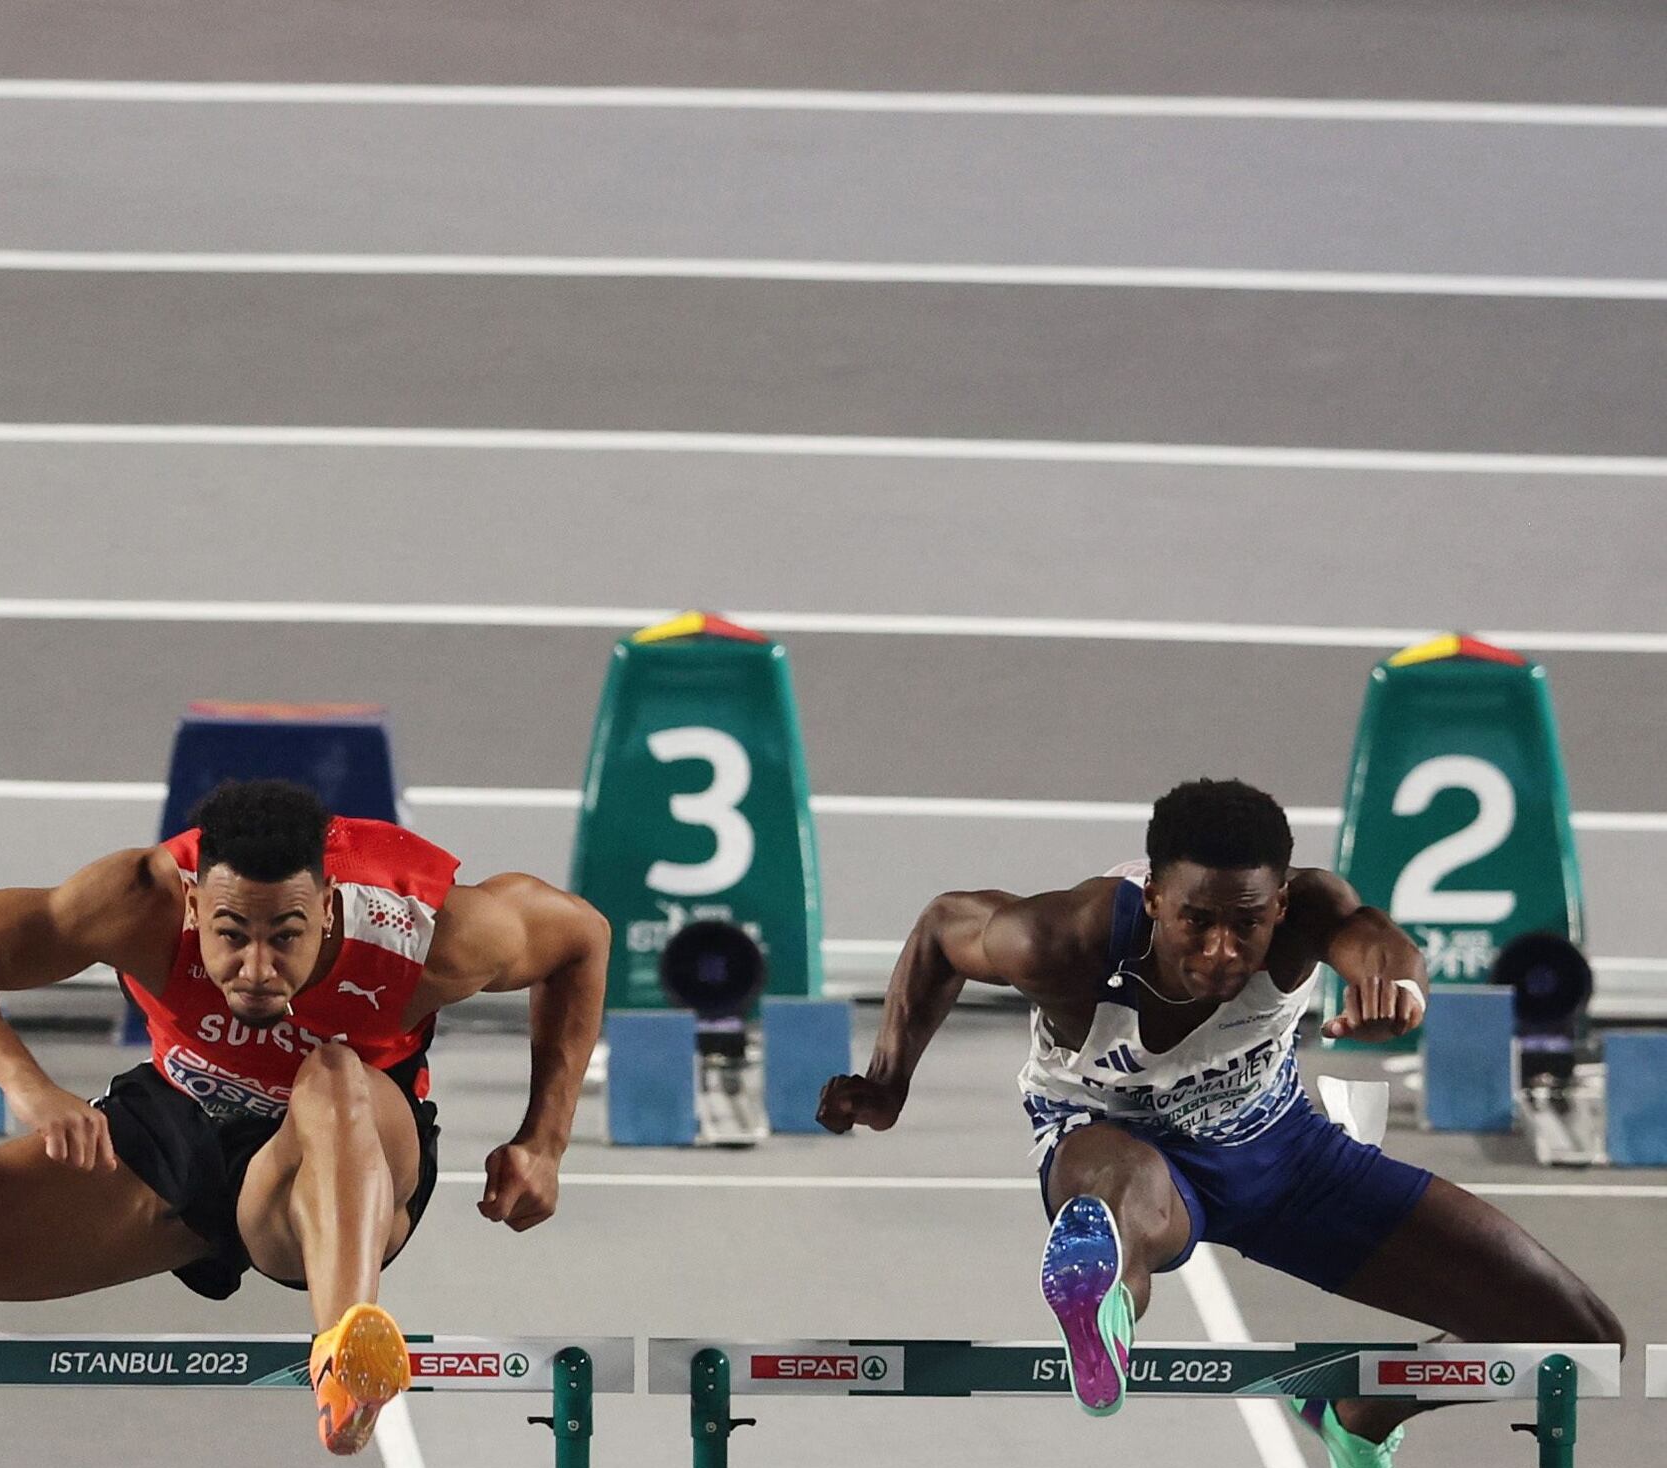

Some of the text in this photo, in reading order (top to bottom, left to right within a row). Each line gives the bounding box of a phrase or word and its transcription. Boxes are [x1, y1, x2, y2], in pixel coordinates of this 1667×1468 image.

[644, 725, 756, 898] 3
[1389, 753, 1517, 925] 2
[196, 1013, 349, 1056] SUISS
[49, 1351, 249, 1375] ISTANBUL 2023
[419, 1356, 499, 1375] SPAR
[777, 1358, 856, 1377] SPAR
[1032, 1359, 1233, 1383] ISTUL 2023
[1404, 1364, 1484, 1383] SPAR
